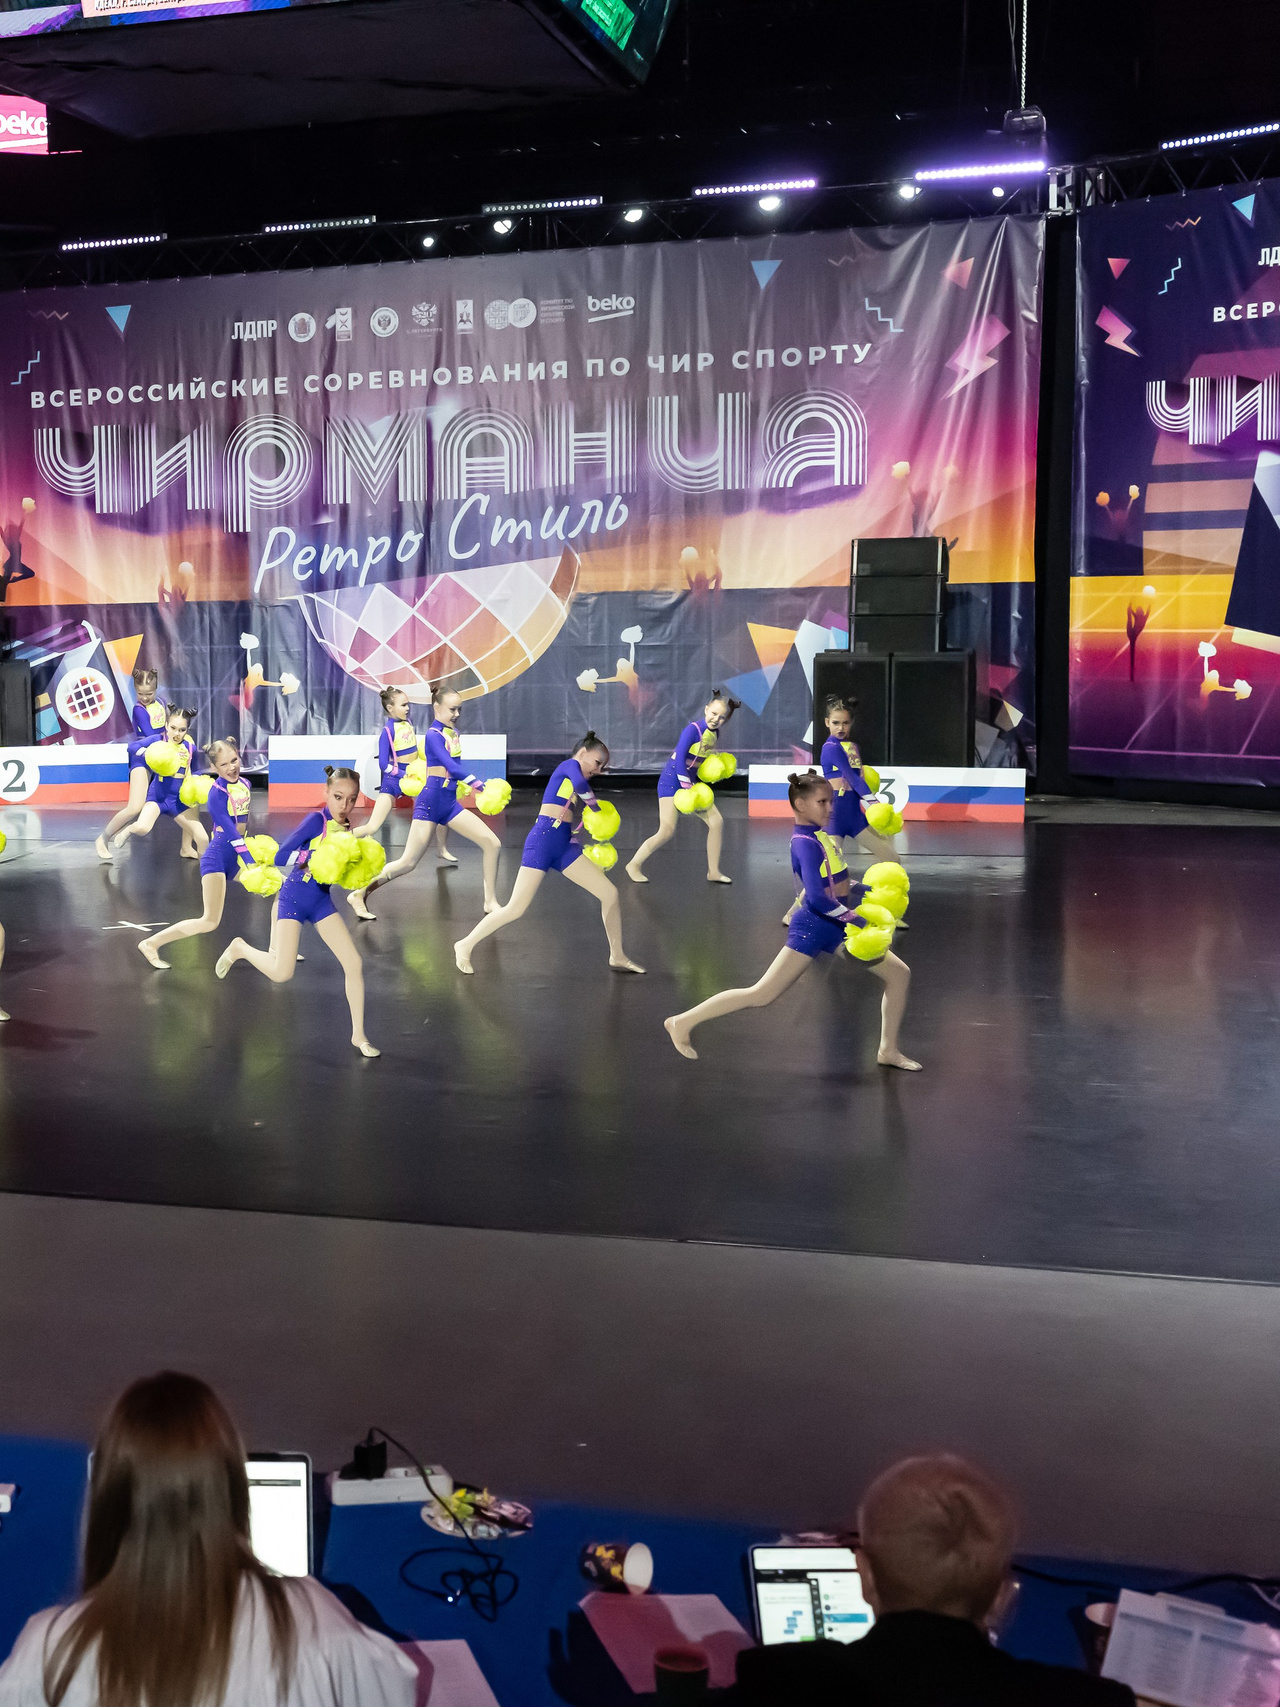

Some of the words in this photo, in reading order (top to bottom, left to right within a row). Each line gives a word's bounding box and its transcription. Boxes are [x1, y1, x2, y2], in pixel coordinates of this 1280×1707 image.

[587, 294, 636, 312] beko
[1213, 300, 1280, 322] ВСЕР
[231, 320, 277, 341] ЛДПР
[31, 376, 288, 408] ВСЕРОССИЙСКИЕ
[303, 360, 568, 393] СОРЕВНОВАНИЯ
[586, 357, 631, 377] ПО
[647, 352, 715, 373] ЧИР
[732, 343, 872, 369] СПОРТУ
[253, 525, 424, 593] Ретро
[448, 492, 629, 560] Стиль
[2, 759, 26, 792] 2
